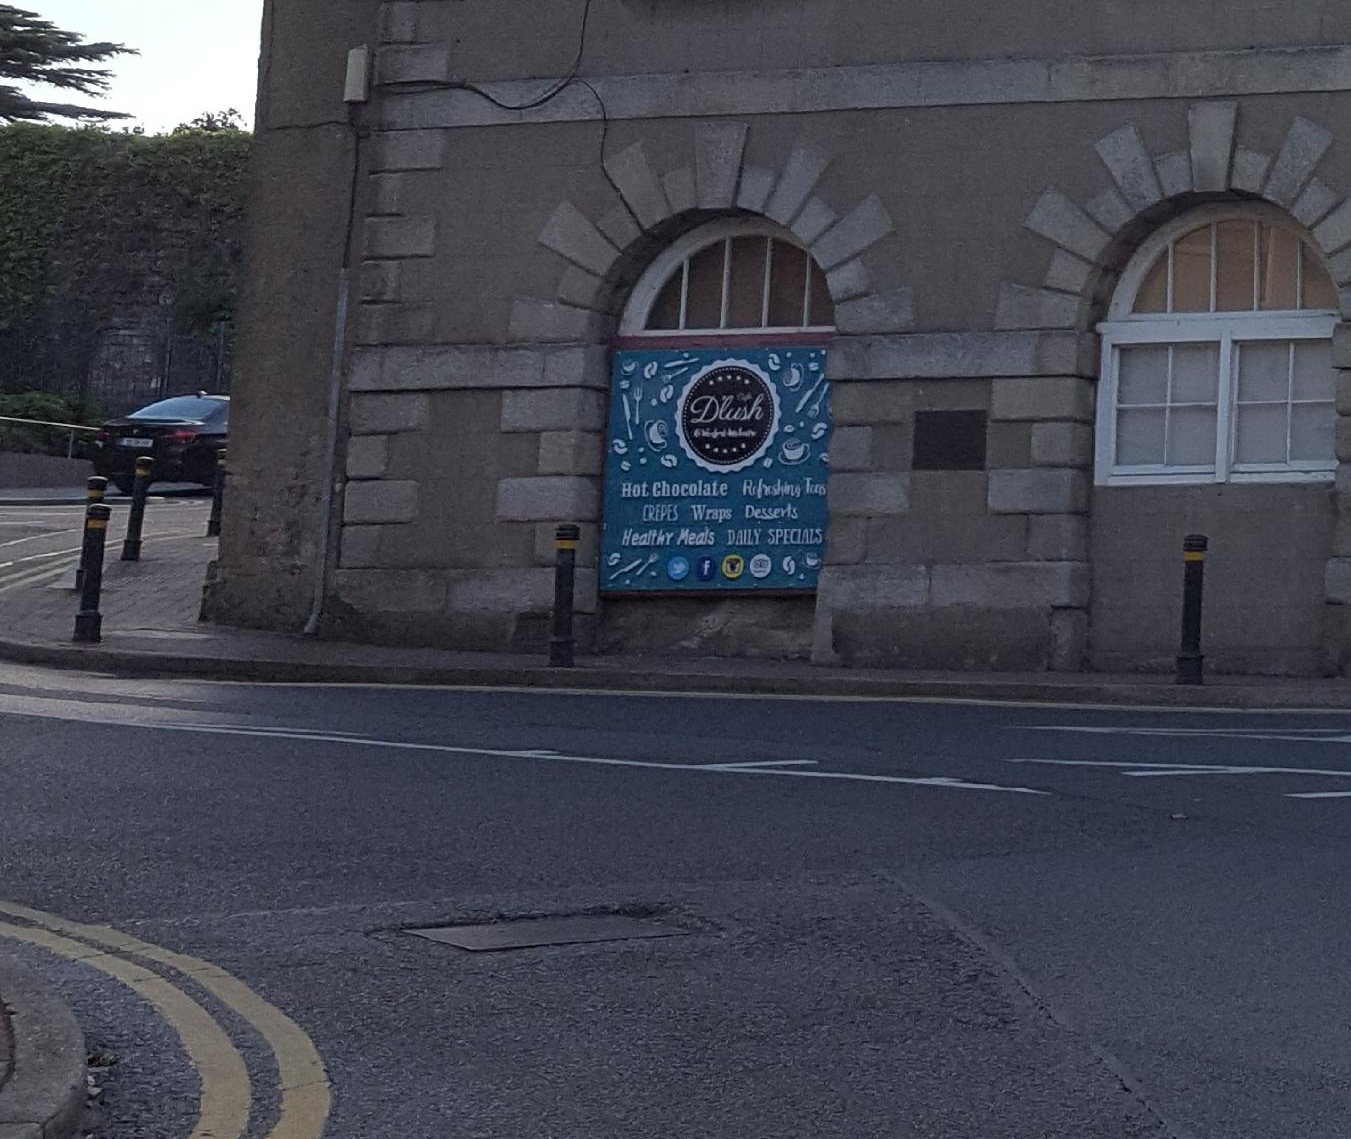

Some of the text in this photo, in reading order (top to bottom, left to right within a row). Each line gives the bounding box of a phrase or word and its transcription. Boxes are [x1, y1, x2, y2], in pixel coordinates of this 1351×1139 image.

[621, 482, 649, 498] Hot
[652, 480, 728, 497] Chocolate
[742, 478, 801, 499] Refreshing
[642, 503, 799, 523] CREPES Wraps Desserts
[677, 527, 716, 546] Meals
[727, 528, 761, 546] DAILY
[767, 527, 823, 545] SPECIALS
